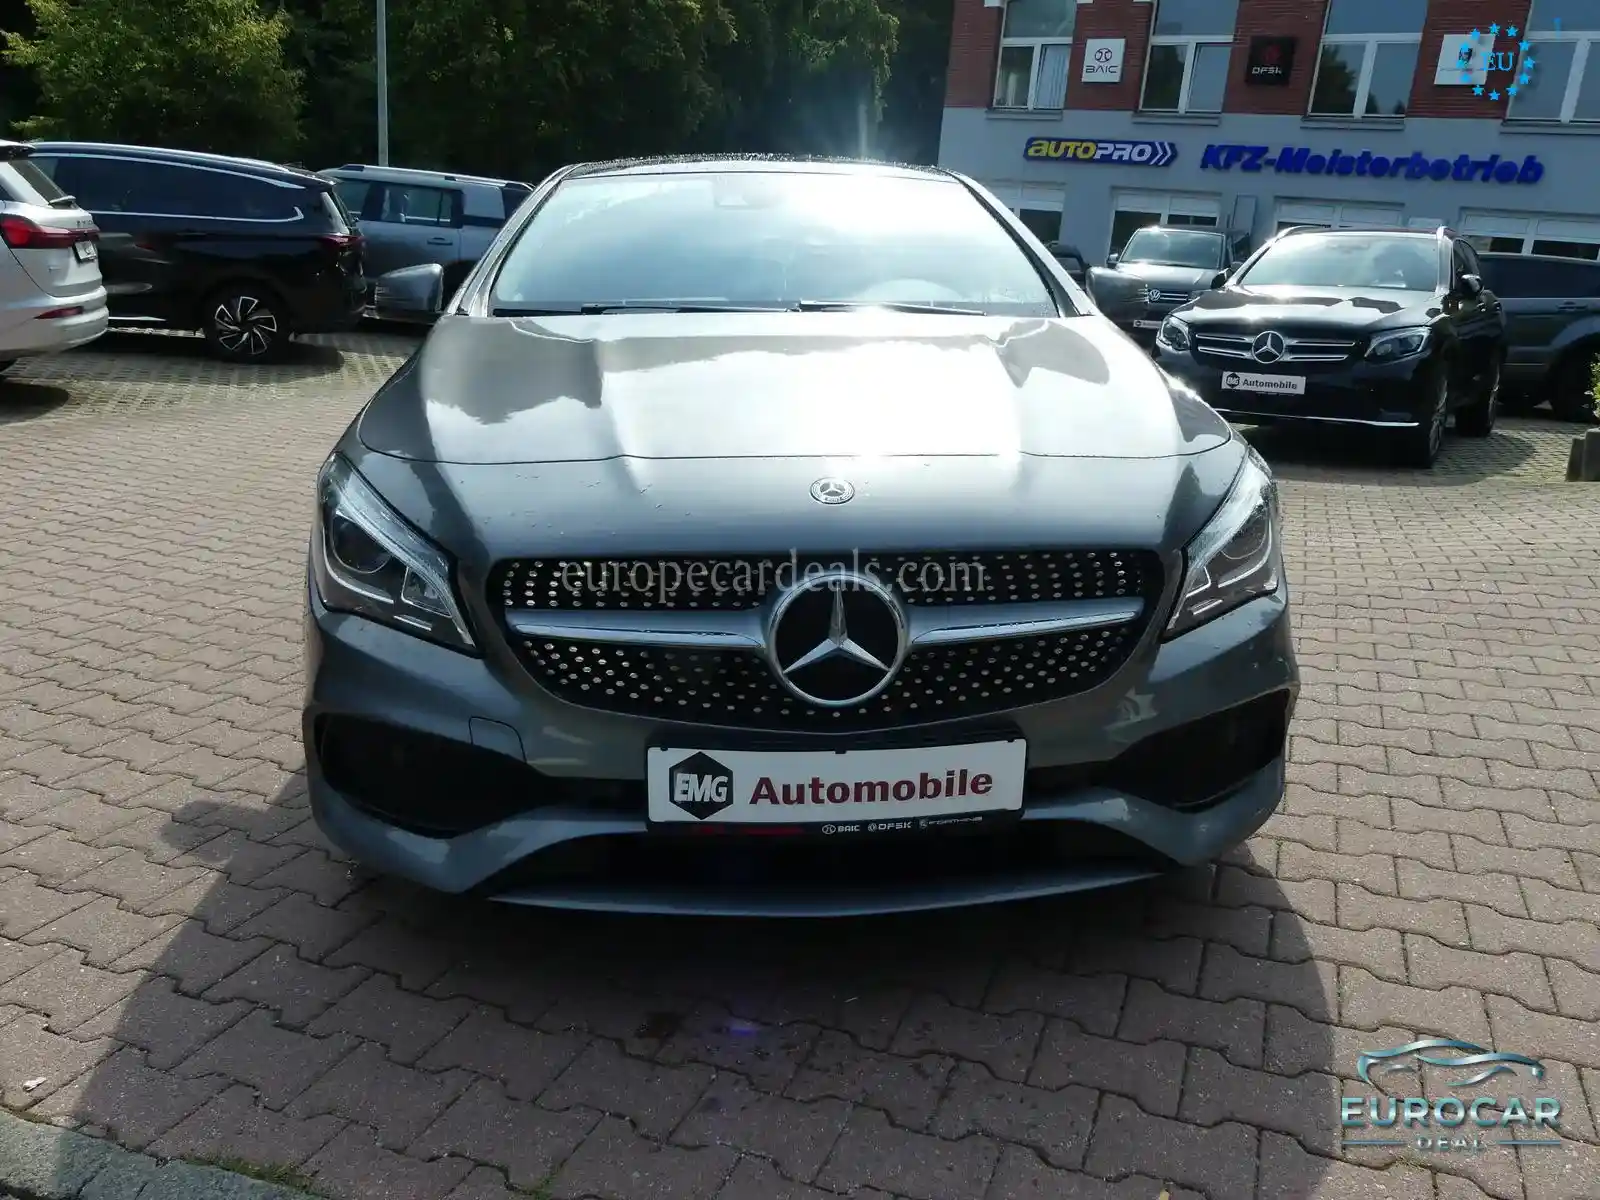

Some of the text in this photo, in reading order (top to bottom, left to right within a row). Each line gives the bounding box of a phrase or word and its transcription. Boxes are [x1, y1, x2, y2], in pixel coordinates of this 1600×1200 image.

[1085, 65, 1119, 74] BAIC
[1200, 144, 1545, 184] KFZ-Meisterbetrieb
[673, 769, 994, 805] EMG Automobile
